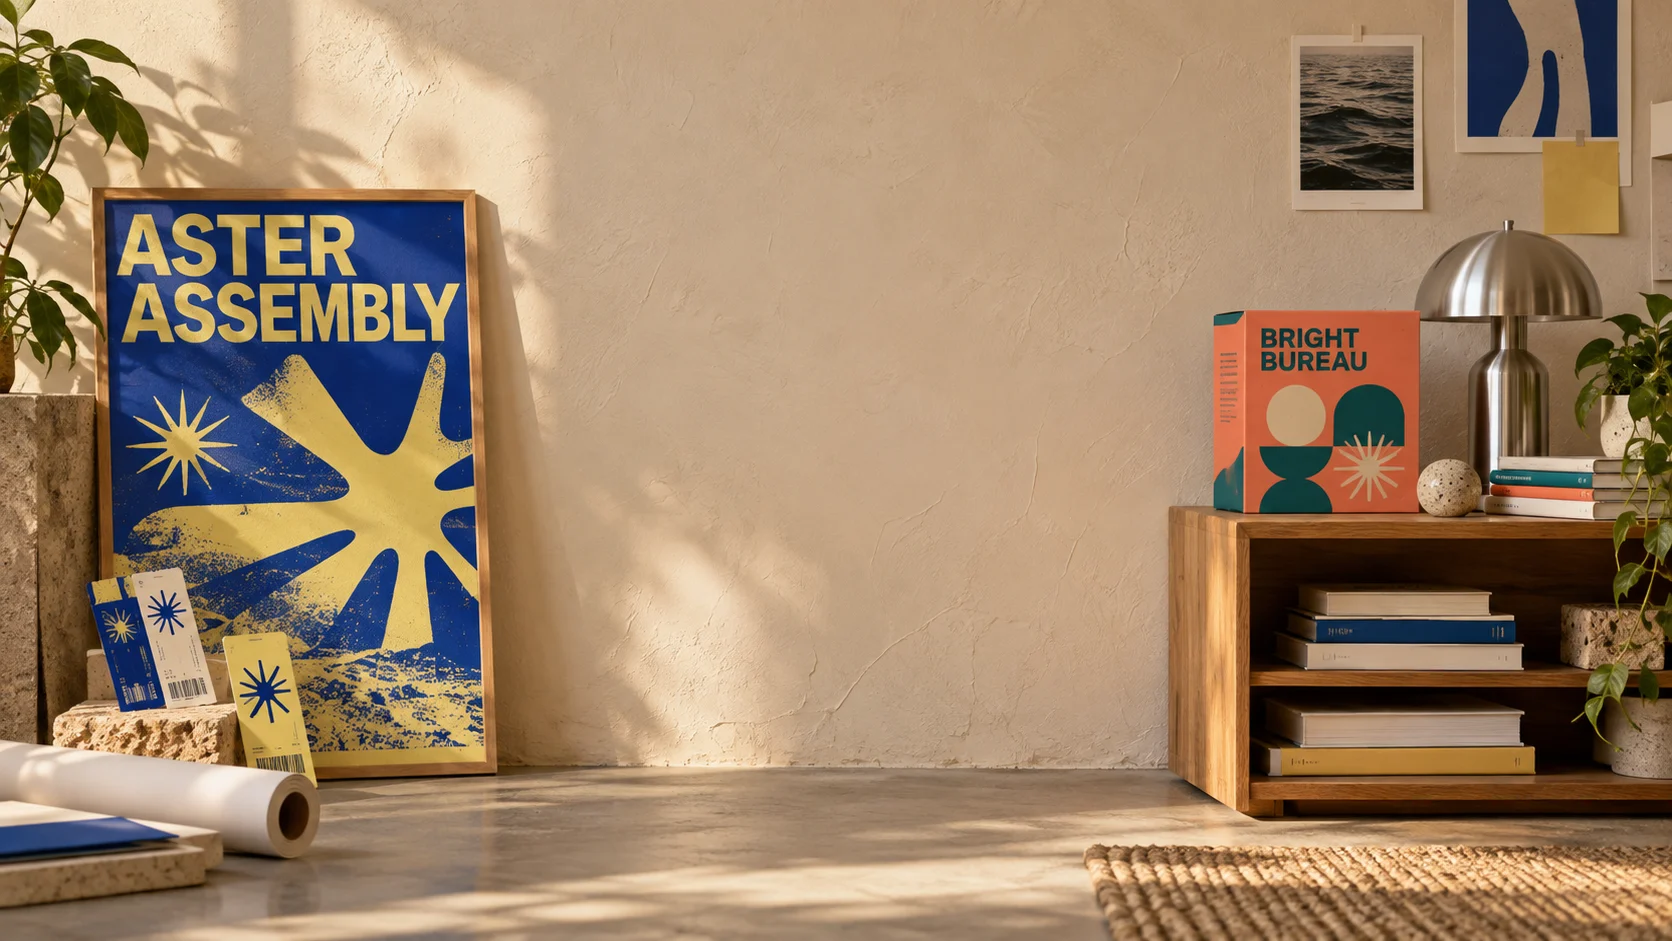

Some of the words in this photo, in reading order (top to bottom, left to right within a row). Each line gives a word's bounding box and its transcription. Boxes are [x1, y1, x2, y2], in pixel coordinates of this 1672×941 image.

[116, 213, 358, 277] ASTER
[121, 282, 461, 343] ASSEMBLY
[1260, 327, 1360, 349] BRIGHT
[1260, 351, 1368, 372] BUREAU
